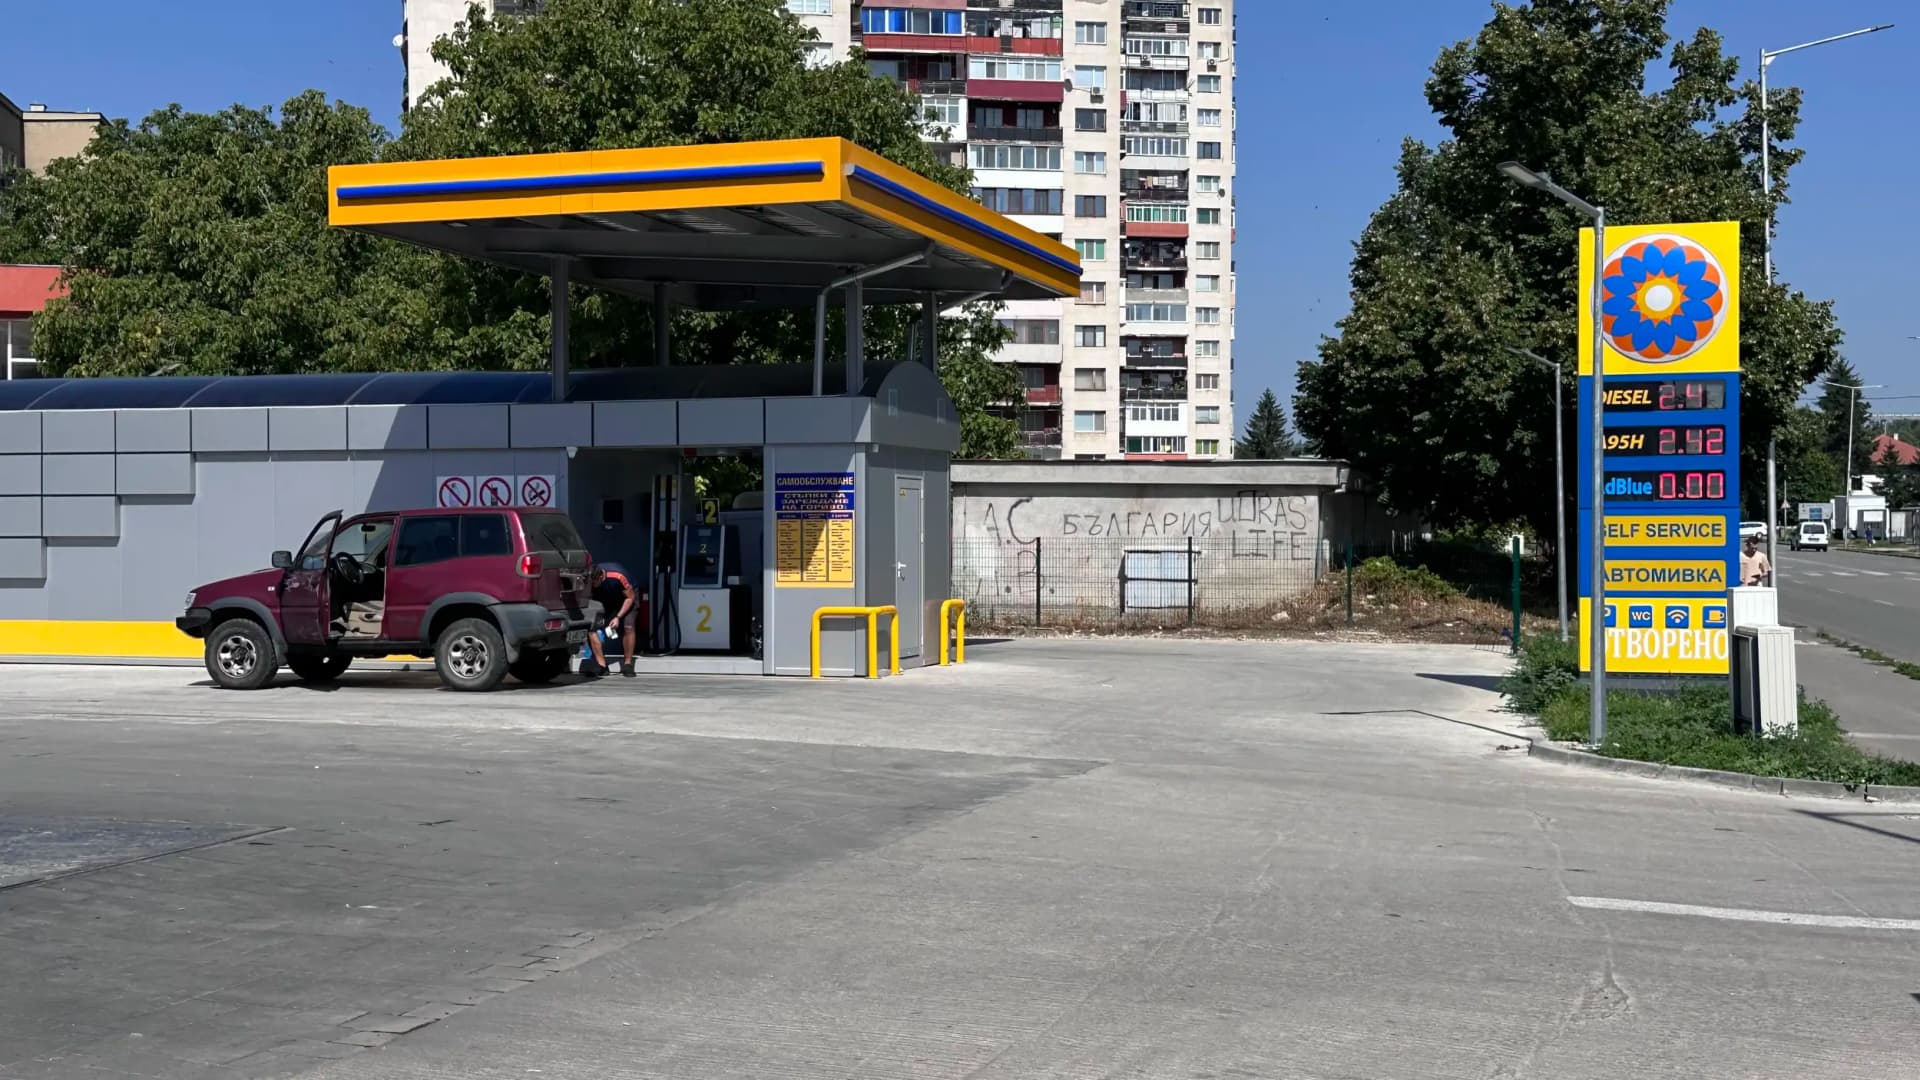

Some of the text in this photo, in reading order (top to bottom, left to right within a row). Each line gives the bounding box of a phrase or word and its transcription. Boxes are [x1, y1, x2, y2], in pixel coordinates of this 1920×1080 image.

[1659, 428, 1723, 454] 2.42
[1603, 477, 1653, 495] dBlue
[1659, 472, 1724, 498] 0.00
[704, 501, 716, 523] 2
[1063, 511, 1211, 537] БЪЛГАРИЯ
[1603, 523, 1722, 538] ELF SERVICE
[1232, 529, 1311, 561] LIFE
[696, 605, 712, 632] 2
[1631, 611, 1651, 621] WC
[1604, 629, 1729, 660] ТВОРЕНО
